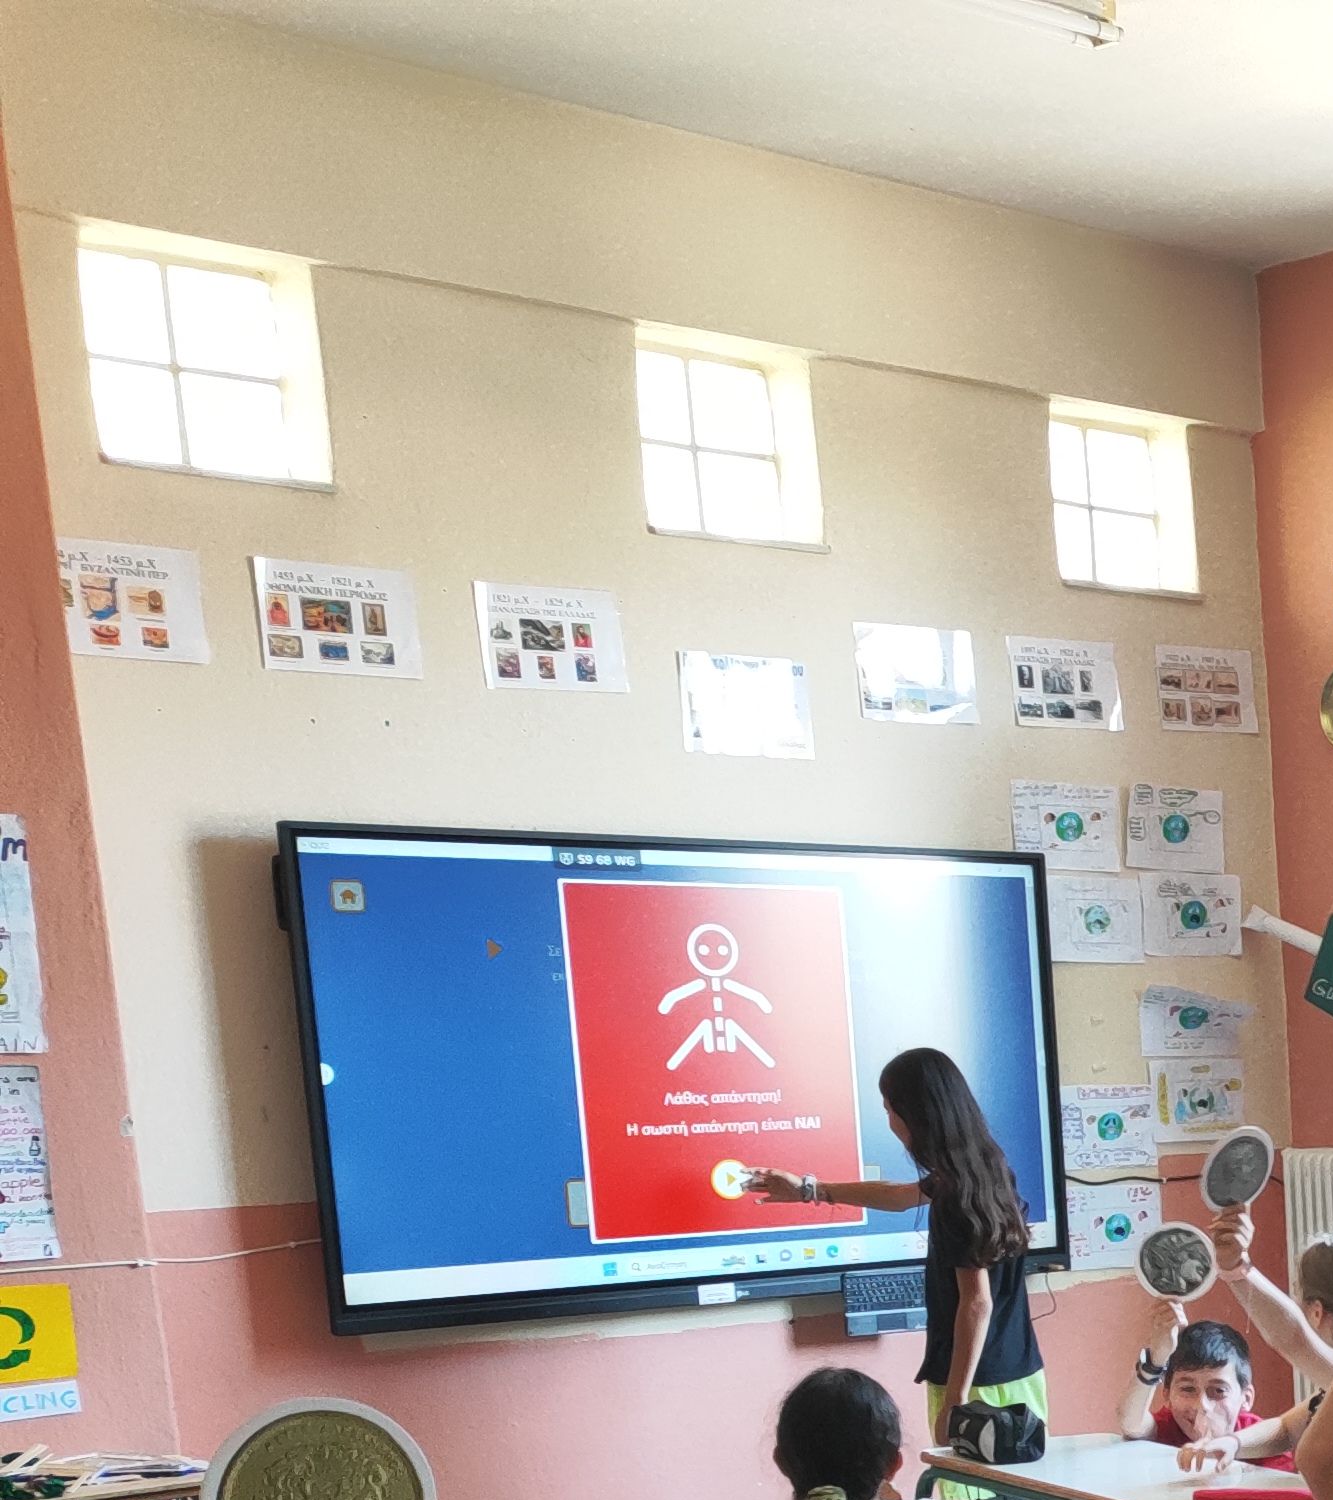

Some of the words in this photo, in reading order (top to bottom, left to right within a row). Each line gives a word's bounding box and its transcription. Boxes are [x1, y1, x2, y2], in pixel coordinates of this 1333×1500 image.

[664, 1091, 709, 1106] Λάθος
[710, 1089, 782, 1104] απάντηση!
[626, 1123, 639, 1136] Η
[641, 1121, 689, 1137] σωστή
[690, 1119, 759, 1135] απάντηση
[794, 1116, 821, 1130] ΝΑΙ
